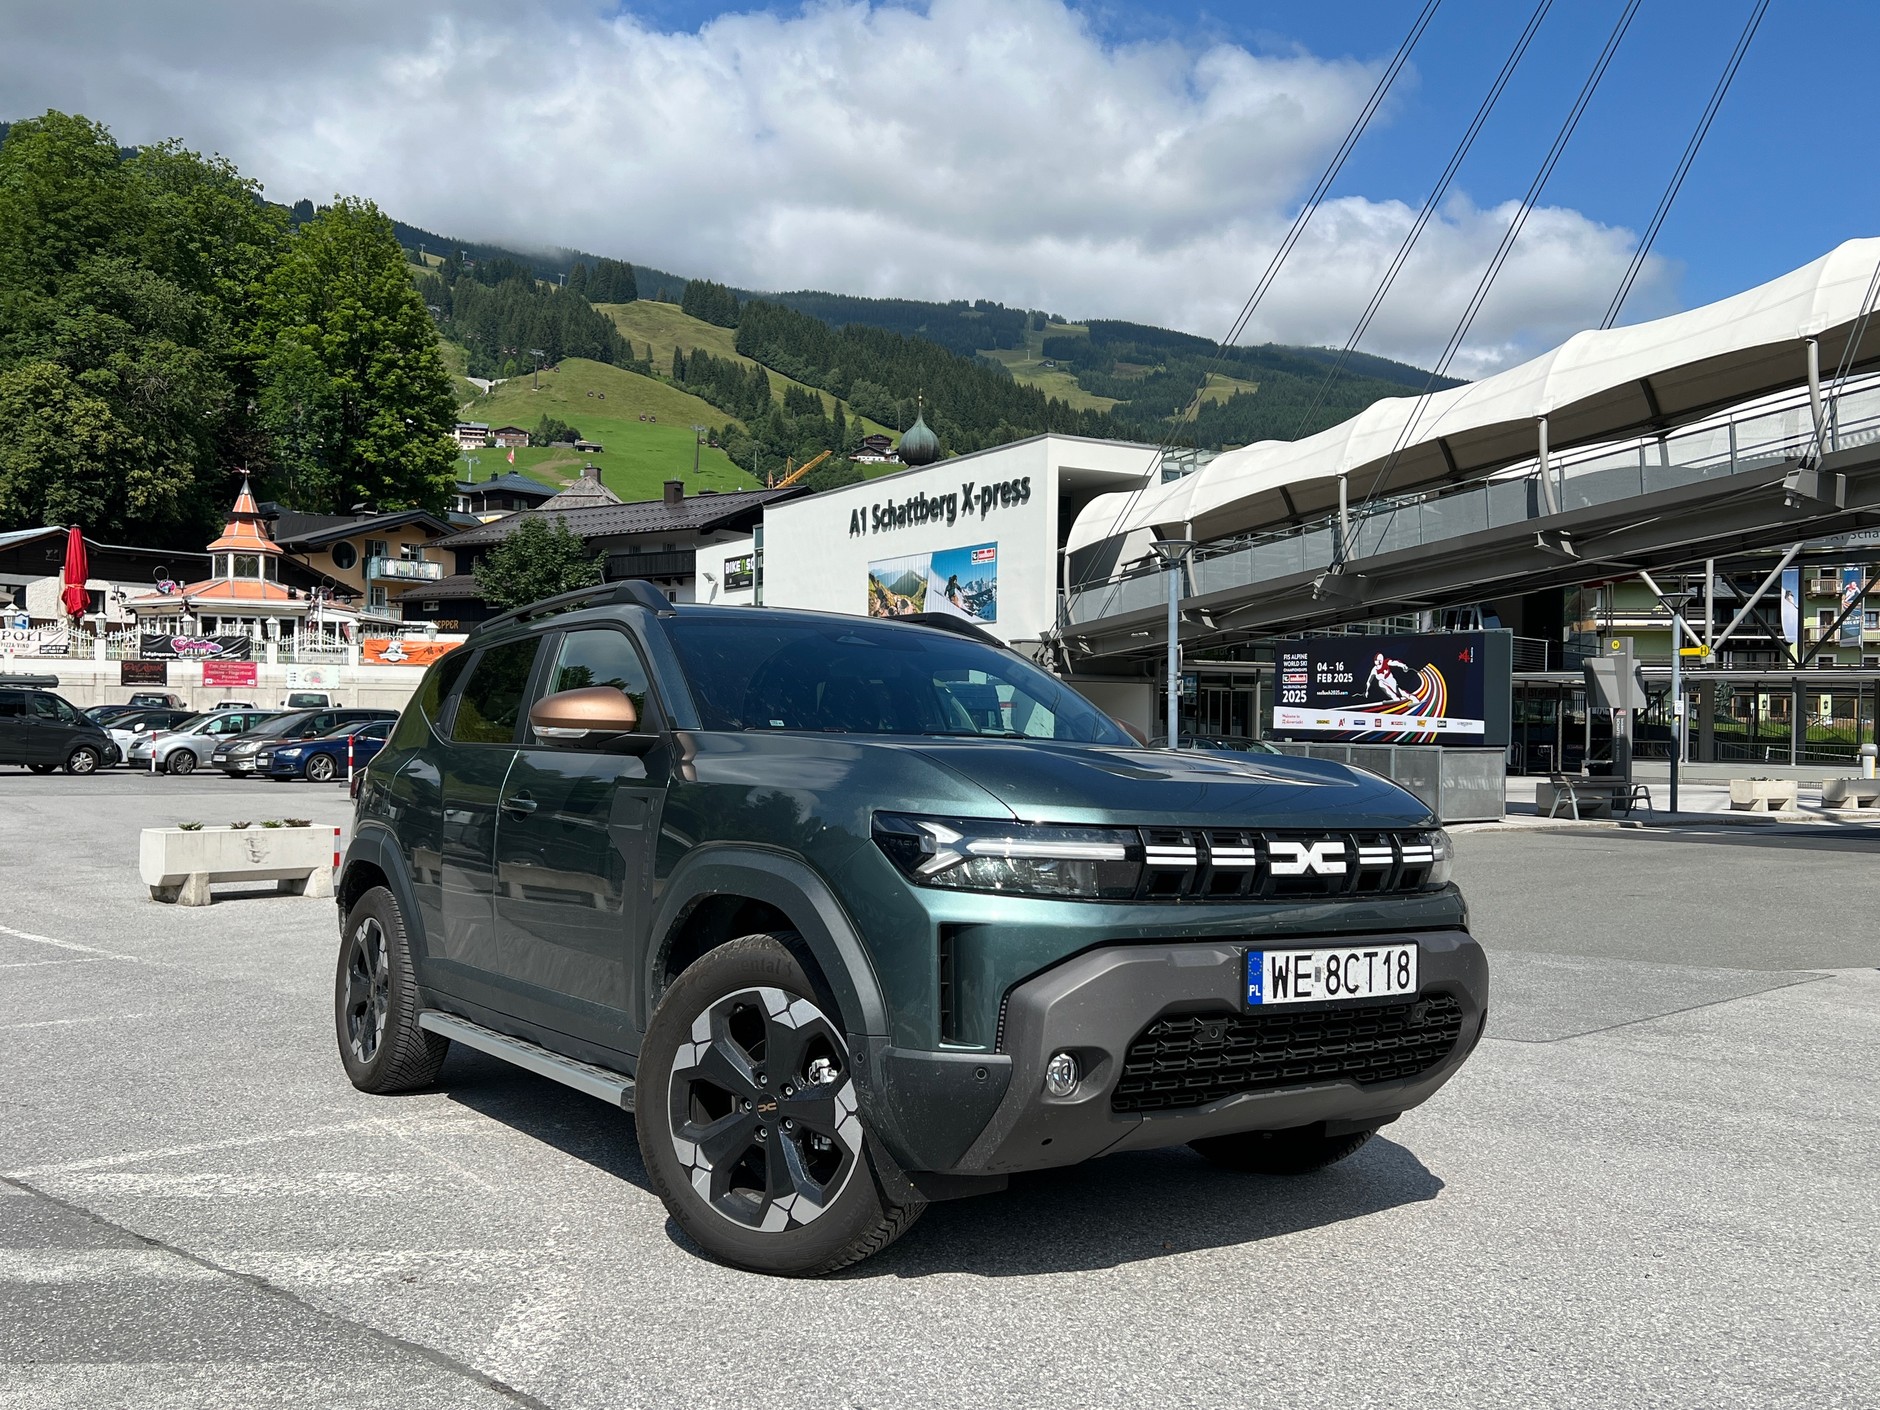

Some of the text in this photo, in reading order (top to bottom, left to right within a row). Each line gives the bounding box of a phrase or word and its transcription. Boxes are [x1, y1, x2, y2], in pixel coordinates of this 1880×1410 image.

[849, 476, 1031, 534] A1 Schattberg X-press
[1317, 662, 1328, 672] 04
[1336, 661, 1344, 671] 16
[1317, 673, 1353, 683] FEB 2025
[1282, 690, 1307, 703] 2025
[1271, 949, 1410, 999] WE 8CT18
[1249, 984, 1261, 997] PL
